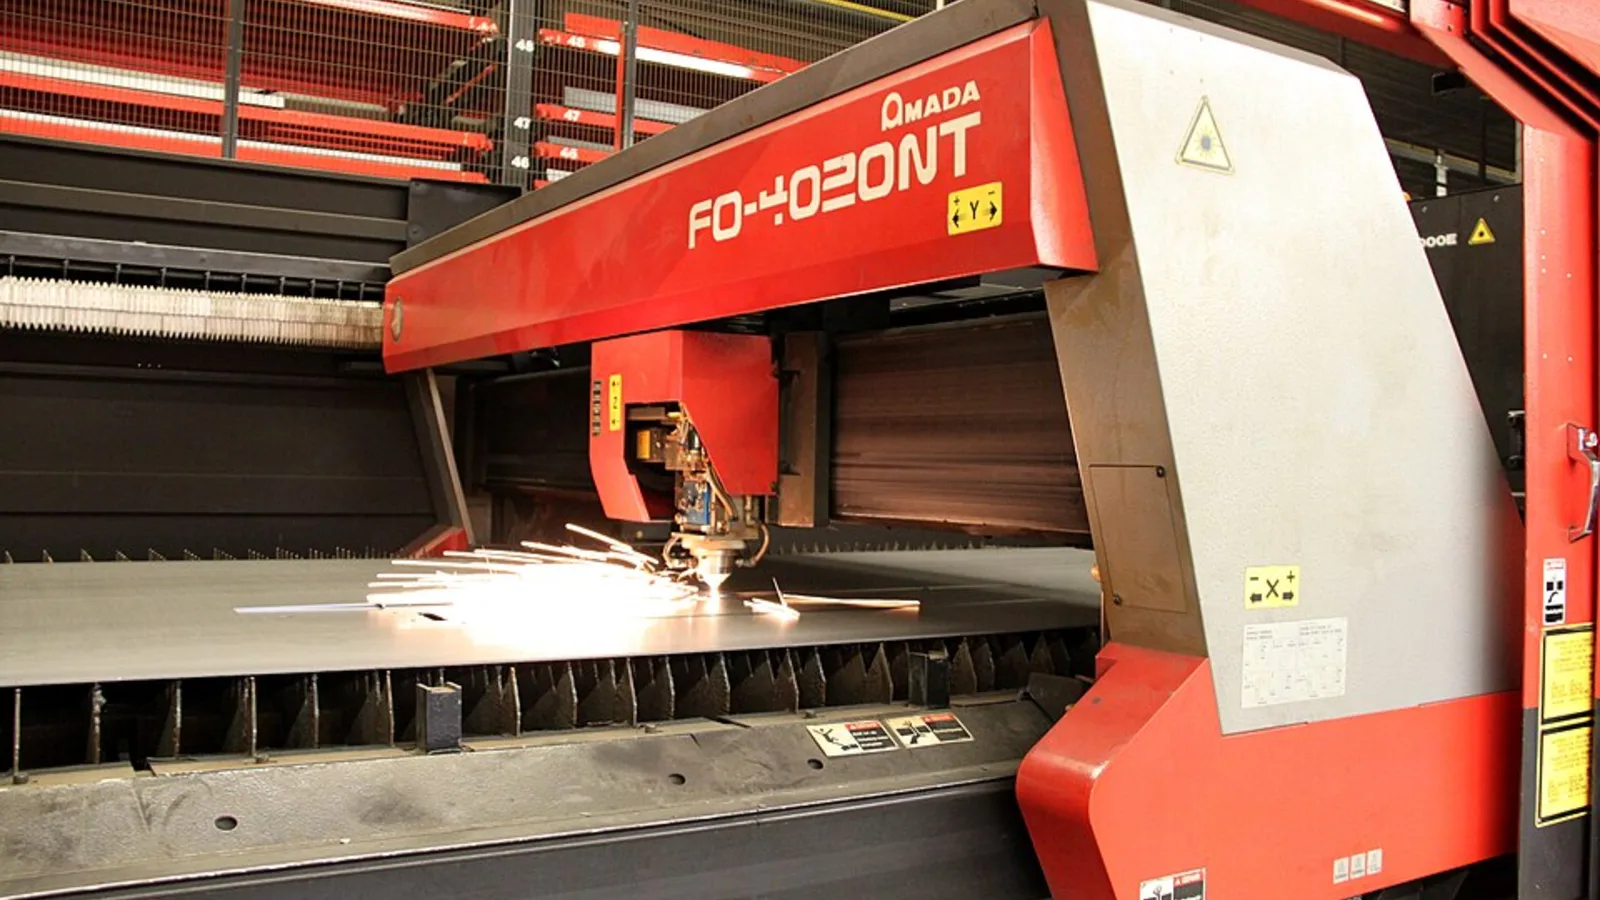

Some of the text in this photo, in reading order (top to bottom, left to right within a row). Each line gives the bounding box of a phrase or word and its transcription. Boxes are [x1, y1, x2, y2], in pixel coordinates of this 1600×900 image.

[563, 109, 581, 121] 47
[881, 80, 981, 131] AMADA
[513, 116, 531, 129] 47
[688, 111, 981, 249] FO-4020NT
[970, 200, 979, 220] Y
[1266, 579, 1279, 598] X
